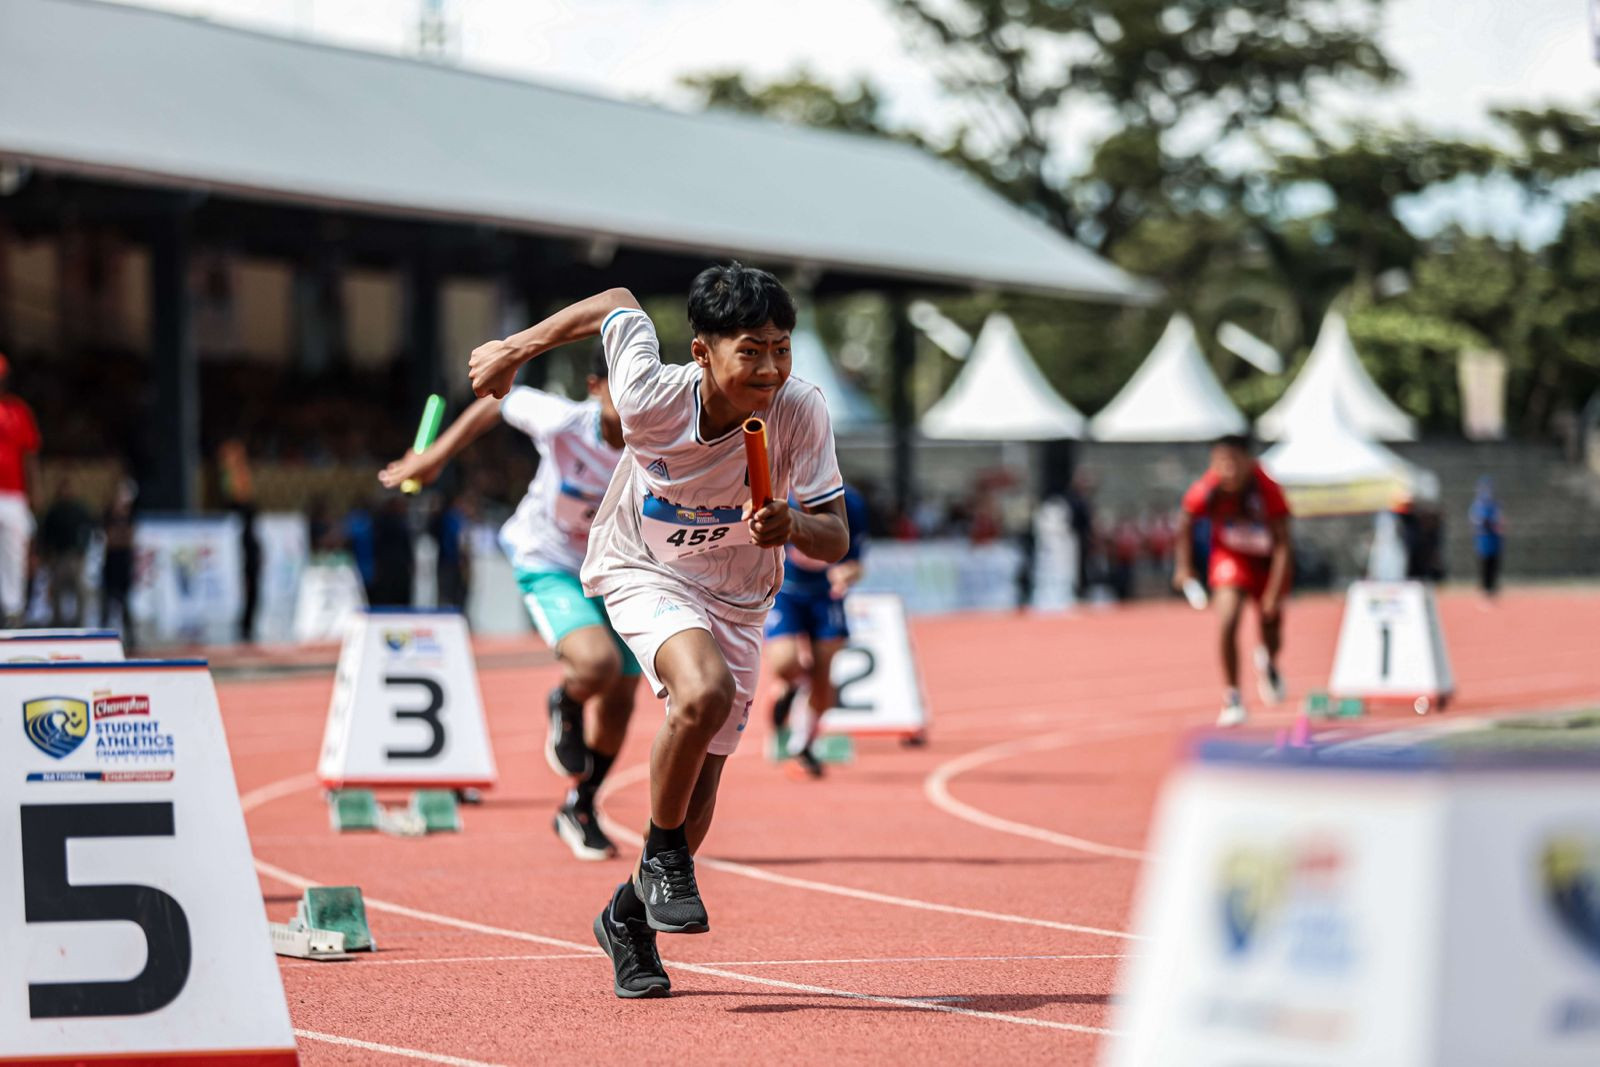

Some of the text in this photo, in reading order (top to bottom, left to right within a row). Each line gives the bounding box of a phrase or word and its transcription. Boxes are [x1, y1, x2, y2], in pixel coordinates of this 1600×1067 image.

[666, 526, 730, 547] 458
[834, 647, 875, 711] 2
[95, 721, 159, 734] STUDENT
[384, 677, 446, 759] 3
[96, 734, 174, 748] ATHLETICS
[42, 773, 87, 781] NATIONAL
[20, 801, 192, 1019] 5
